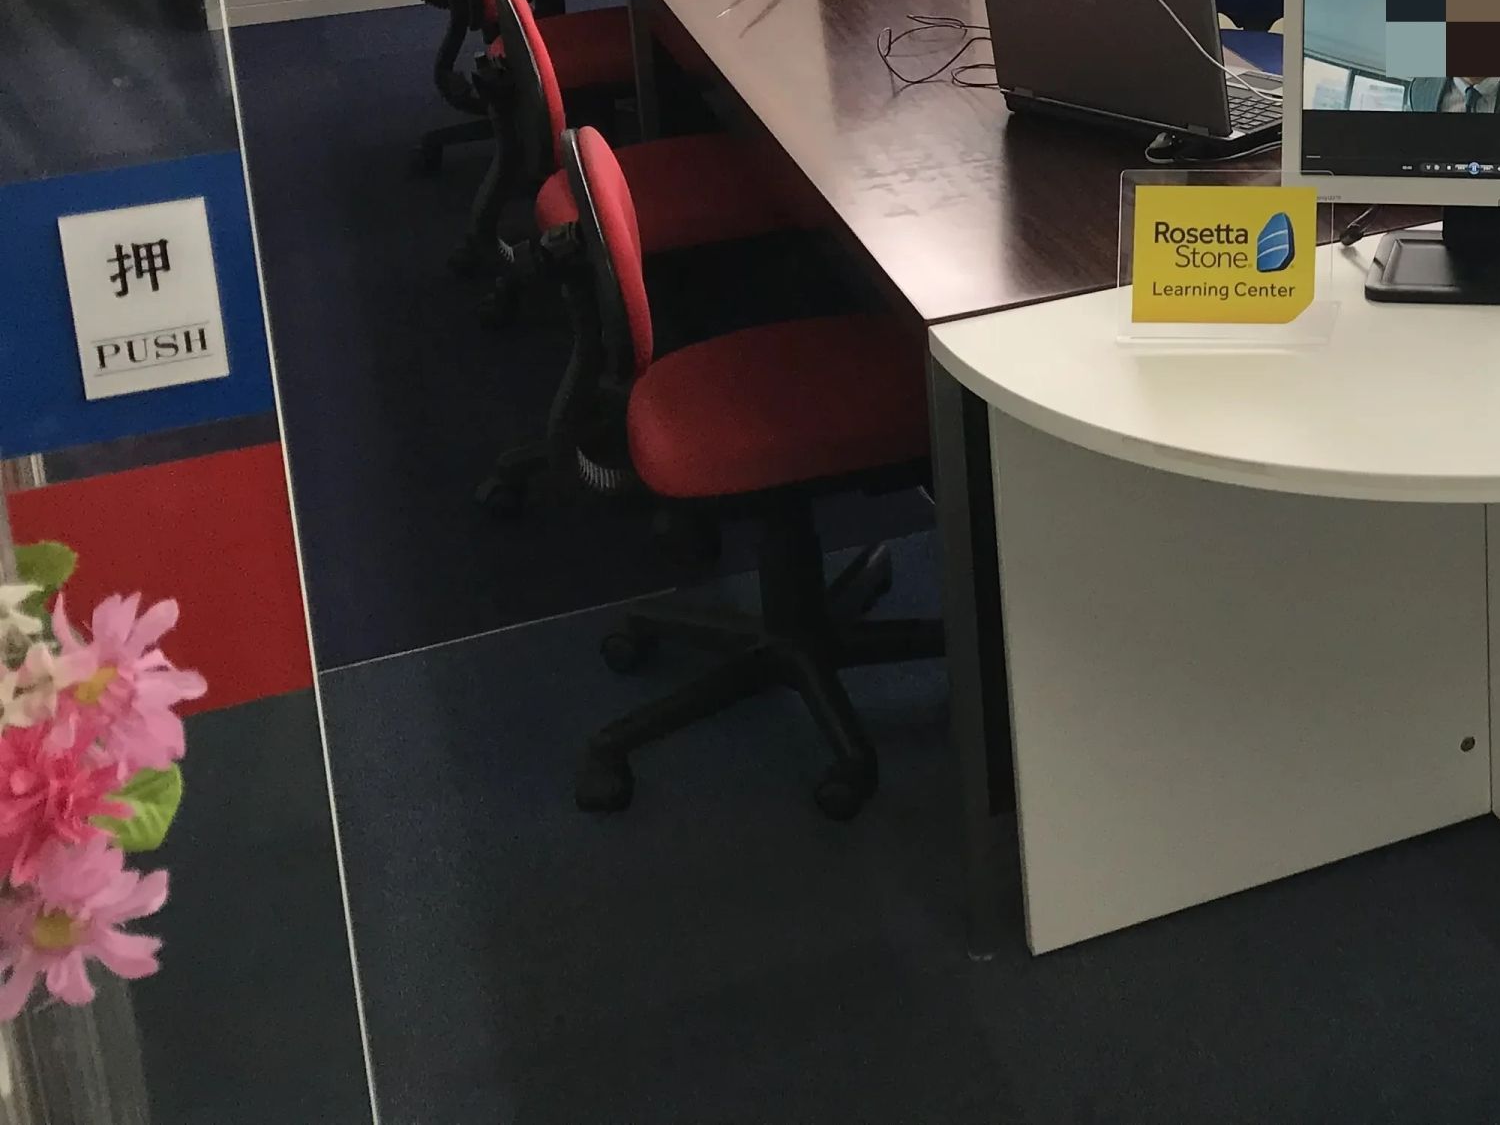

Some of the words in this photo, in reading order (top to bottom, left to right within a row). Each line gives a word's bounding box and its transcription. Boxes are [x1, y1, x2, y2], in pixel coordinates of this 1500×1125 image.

[1154, 221, 1249, 244] Rosetta
[106, 237, 171, 298] 押
[1175, 245, 1249, 269] Stone
[1152, 282, 1230, 301] Learning
[1234, 282, 1296, 298] Center
[95, 328, 209, 370] PUSH
